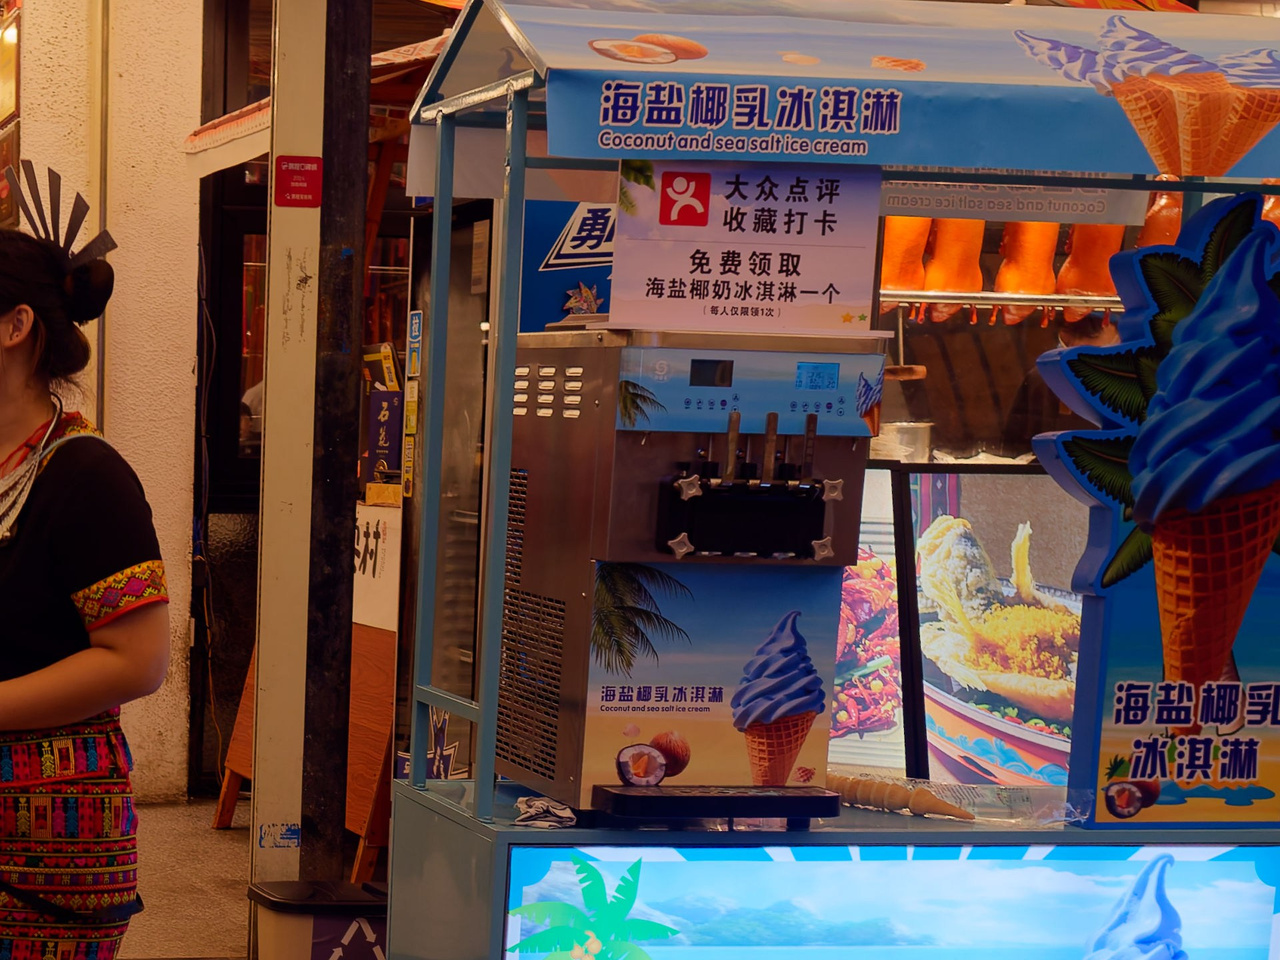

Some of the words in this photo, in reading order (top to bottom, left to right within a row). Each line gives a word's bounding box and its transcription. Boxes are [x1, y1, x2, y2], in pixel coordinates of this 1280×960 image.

[601, 81, 902, 133] 海盐椰乳冰淇淋
[599, 131, 674, 150] Coconut
[677, 132, 712, 151] and
[715, 137, 746, 152] sea
[749, 133, 781, 153] salt
[784, 134, 810, 153] ice
[813, 138, 868, 155] cream
[725, 174, 840, 204] 大众点评
[570, 208, 616, 250] 勇
[723, 206, 838, 236] 收藏打卡
[689, 248, 802, 277] 免费领取
[645, 277, 841, 304] 海盐椰奶冰淇淋一个
[600, 704, 630, 712] Coconut
[631, 704, 646, 712] and
[661, 704, 674, 713] salt
[675, 705, 686, 713] ice
[601, 685, 724, 703] 海盐椰乳冰淇淋
[1114, 682, 1280, 726] 海盐椰乳
[1131, 737, 1260, 780] 冰淇淋
